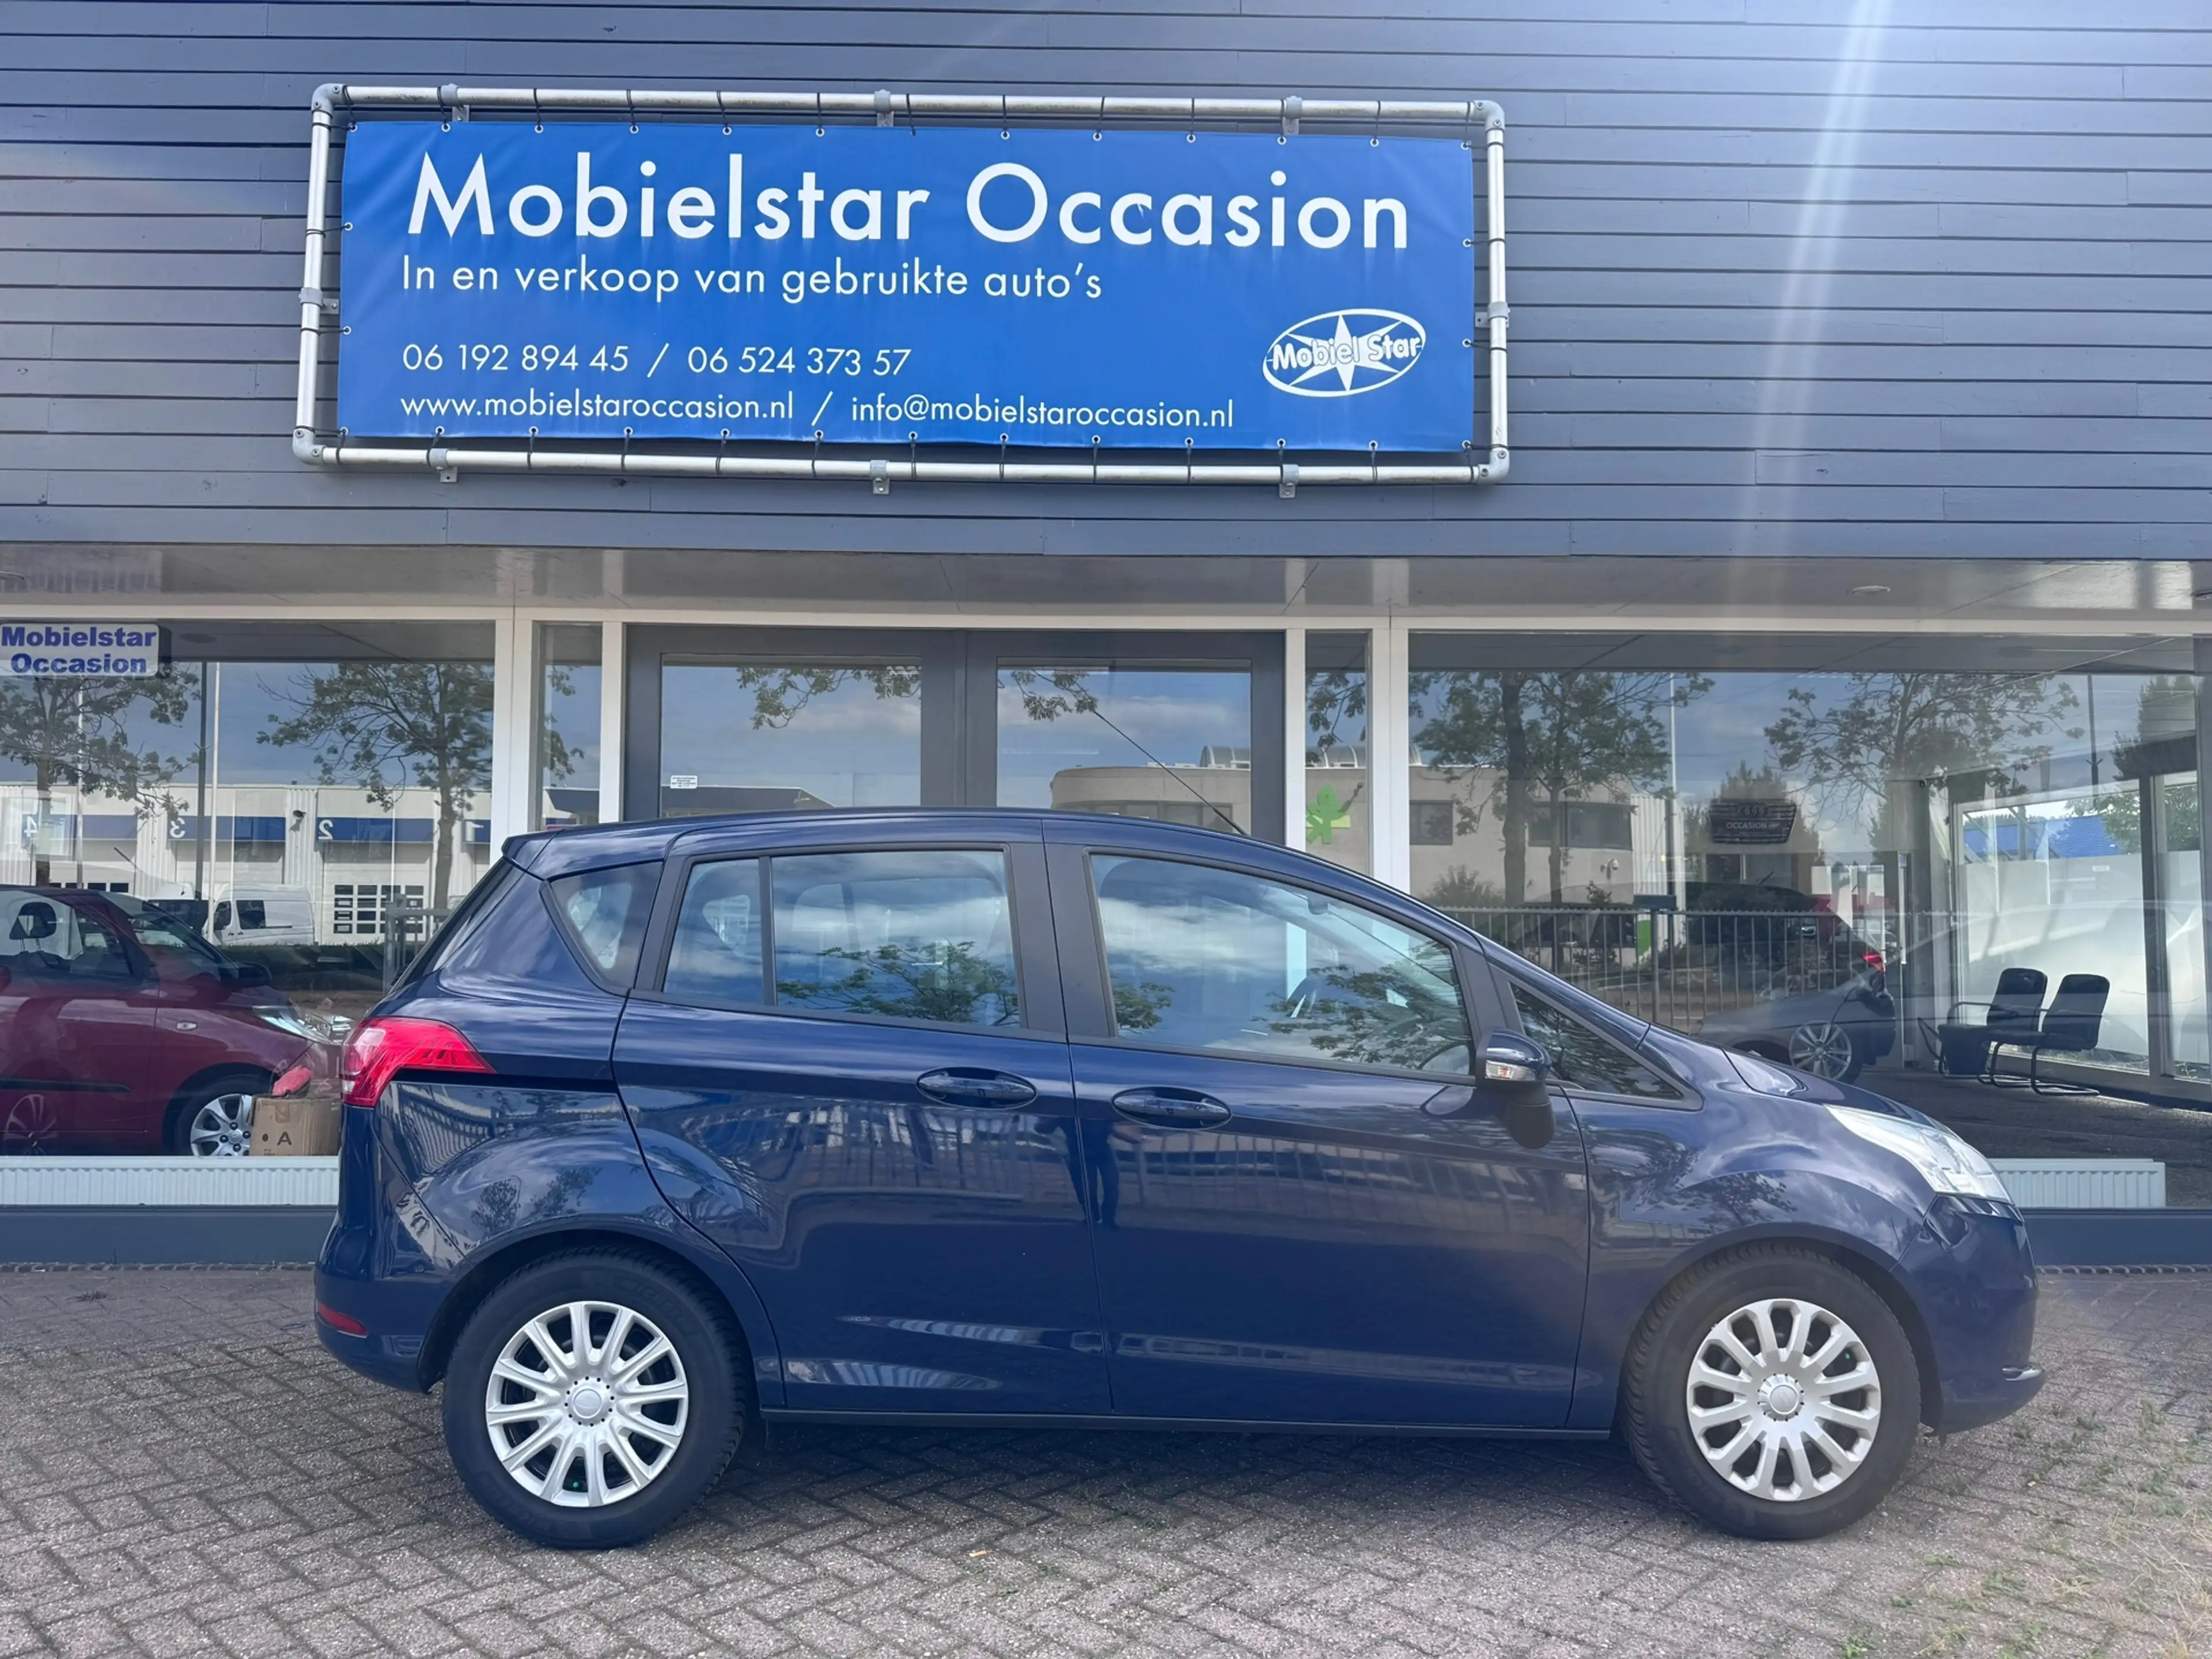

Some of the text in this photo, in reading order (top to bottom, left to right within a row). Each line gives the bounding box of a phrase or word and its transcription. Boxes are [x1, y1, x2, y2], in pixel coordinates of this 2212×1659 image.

[408, 152, 1407, 249] Mobielstar Occasion
[403, 254, 1101, 304] In en verkoop van gebruikte auto's
[403, 343, 911, 377] 06 192 894 45 / 06 524 373 57
[1272, 334, 1420, 370] Mobiel Star
[401, 388, 1233, 429] www.mobielstaroccasion.nl / info@mobielstaroccasion.nl
[1, 627, 157, 646] Mobielstar
[11, 653, 146, 673] Occasion
[1726, 821, 1768, 830] OCCASION
[276, 1131, 293, 1146] A
